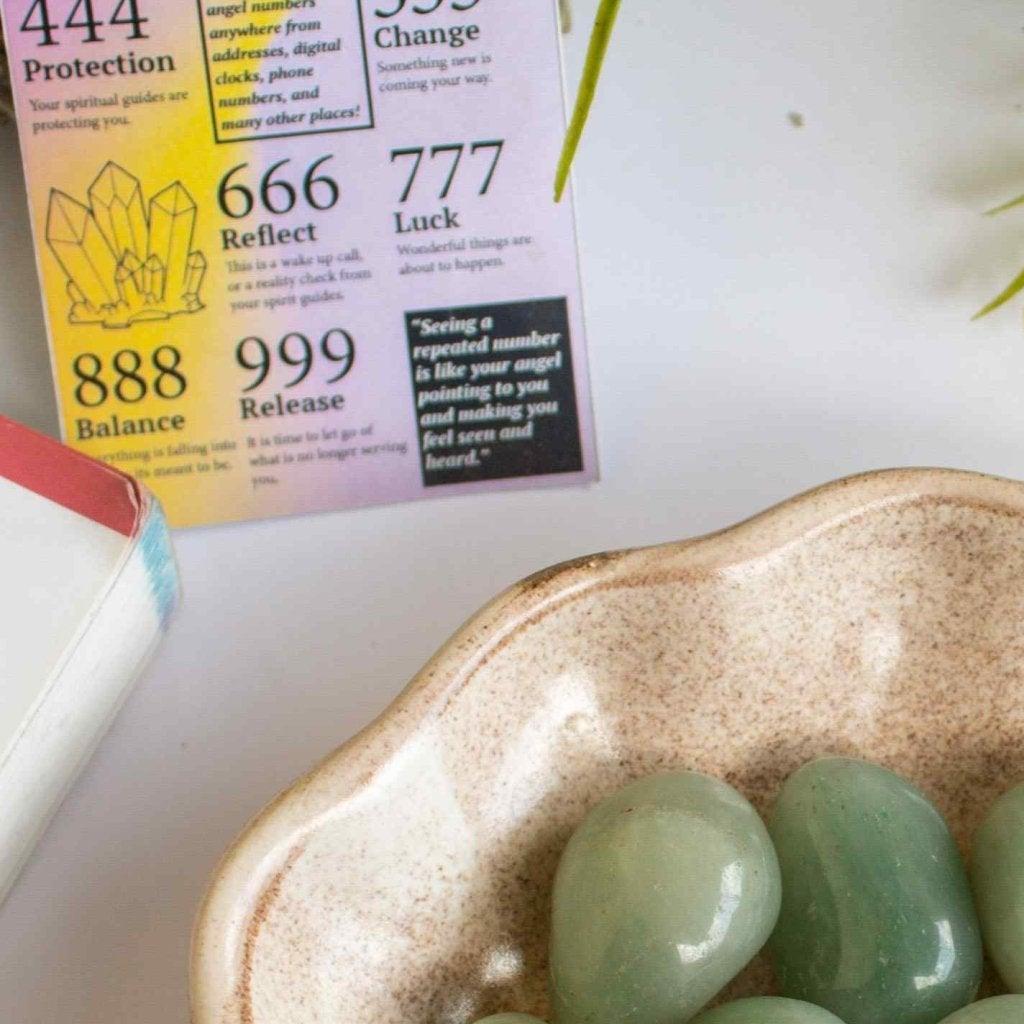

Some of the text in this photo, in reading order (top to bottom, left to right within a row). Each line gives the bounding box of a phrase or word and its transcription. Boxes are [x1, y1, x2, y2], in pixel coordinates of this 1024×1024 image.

[206, 0, 316, 18] angel numbers
[20, 0, 149, 46] 444
[209, 19, 321, 41] anywhere from
[374, 24, 480, 48] Change
[293, 38, 341, 57] digital
[22, 51, 176, 82] Protection
[268, 65, 314, 84] phone
[377, 53, 492, 73] Something new is
[291, 86, 320, 101] and
[378, 78, 428, 93] coming
[432, 75, 461, 91] your
[29, 90, 188, 112] Your spiritual guides are
[32, 118, 99, 134] protecting
[221, 116, 262, 130] many
[266, 112, 305, 126] other
[390, 139, 505, 203] 777
[217, 154, 339, 219] 666
[394, 206, 460, 234] Luck
[221, 223, 319, 250] Reflect
[512, 235, 532, 245] are
[413, 330, 562, 361] repeated number
[236, 327, 355, 393] 999
[415, 351, 562, 383] is like your angel
[73, 344, 187, 408] 888
[239, 393, 345, 420] Release
[418, 384, 492, 408] pointing
[516, 379, 550, 398] you
[75, 414, 185, 440] Balance
[420, 400, 559, 427] and making you
[423, 428, 454, 450] feel
[499, 422, 534, 440] and
